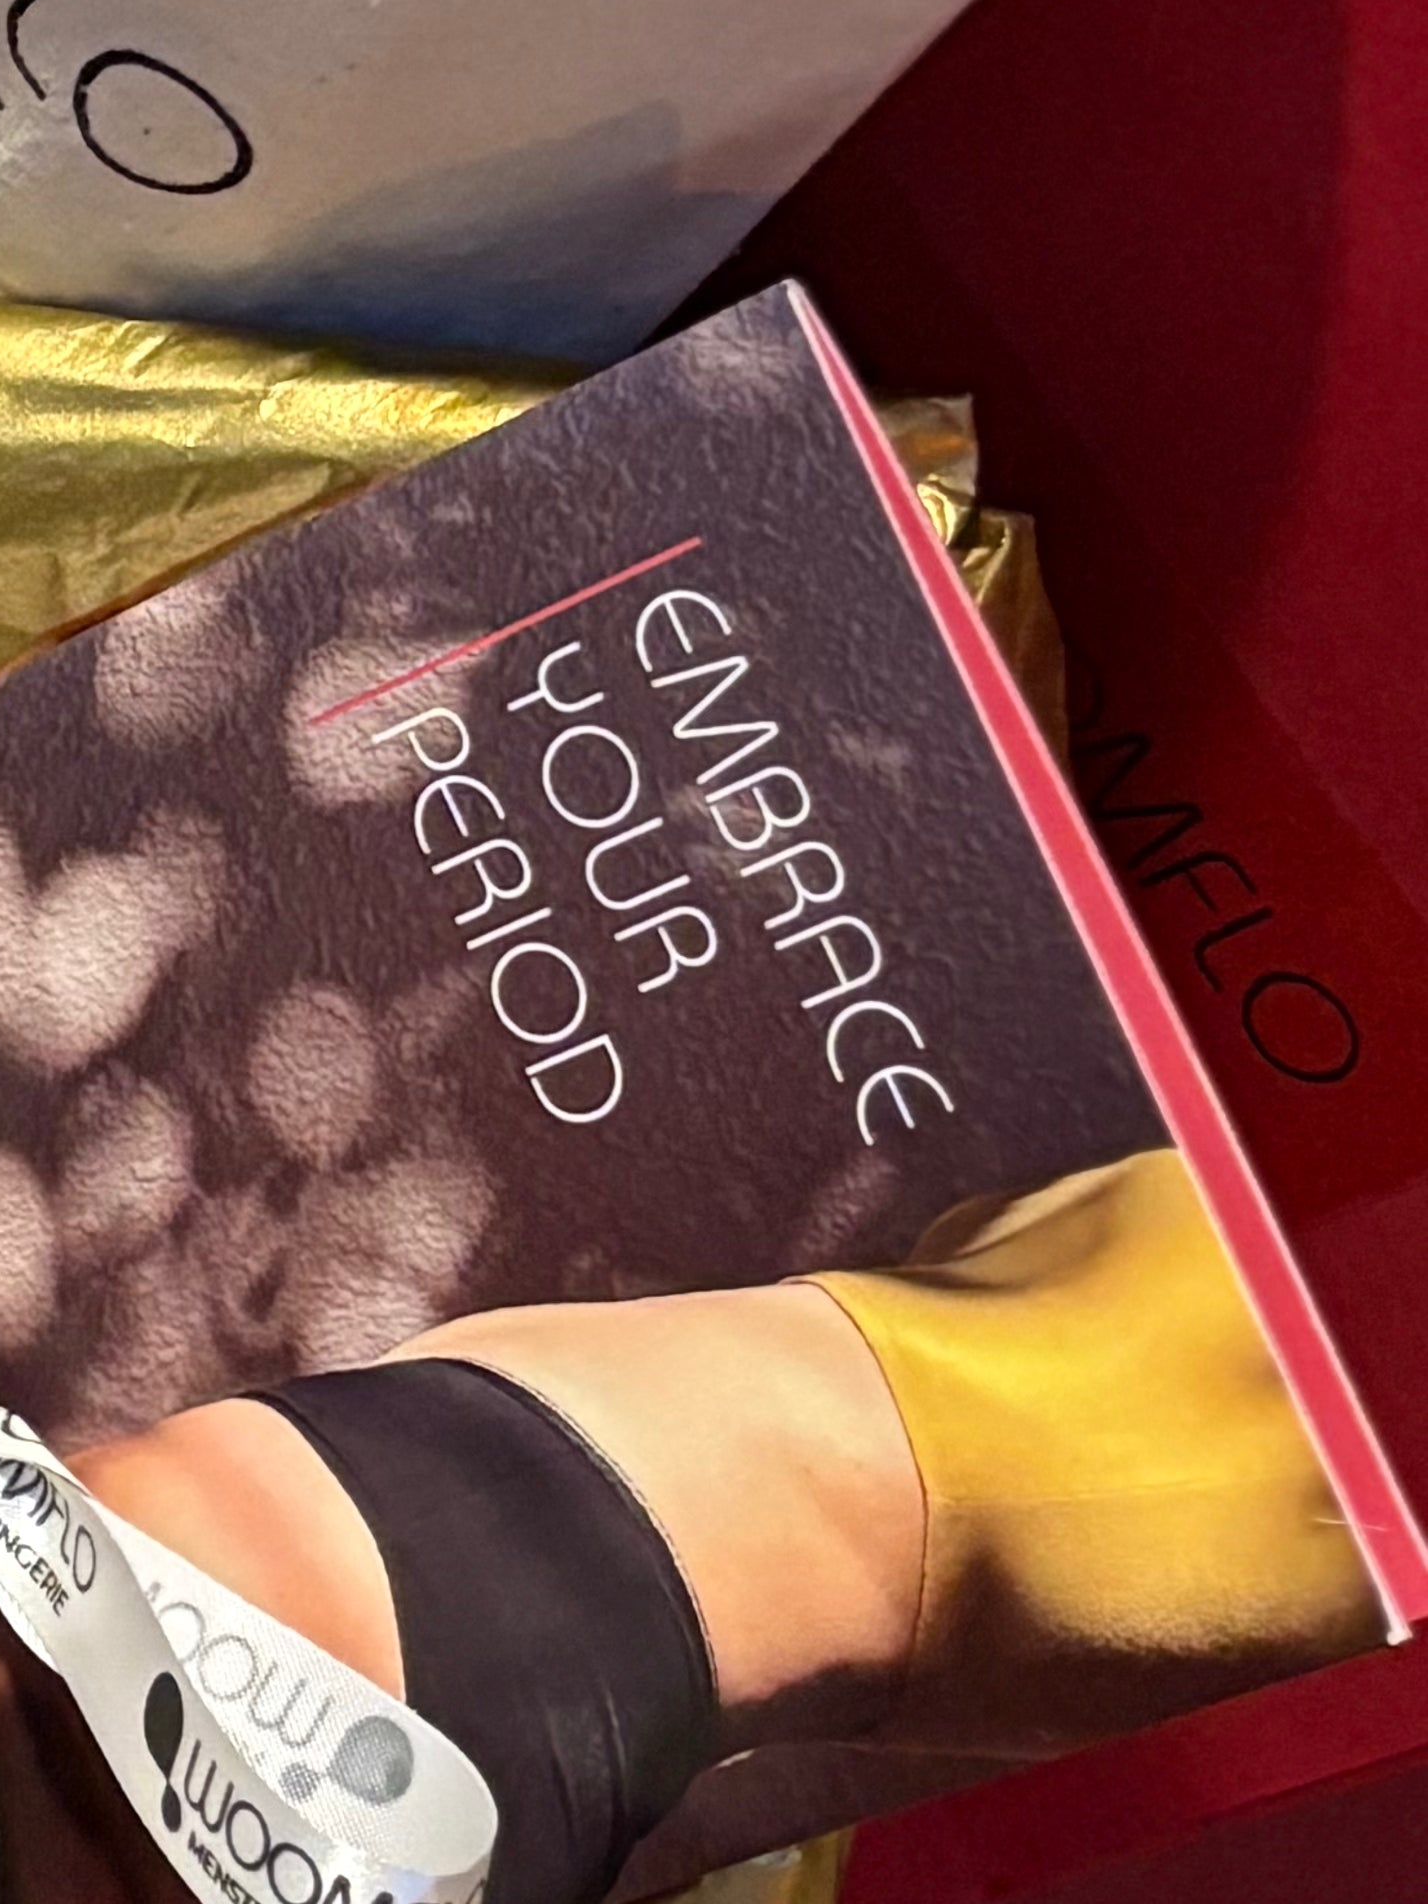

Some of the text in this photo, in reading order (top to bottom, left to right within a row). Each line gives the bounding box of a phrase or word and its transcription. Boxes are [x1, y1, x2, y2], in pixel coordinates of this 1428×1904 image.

[371, 706, 624, 1124] PERIOD
[507, 641, 718, 994] YOUR
[635, 589, 954, 1147] EMBRACE
[1072, 732, 1360, 1084] MFLO
